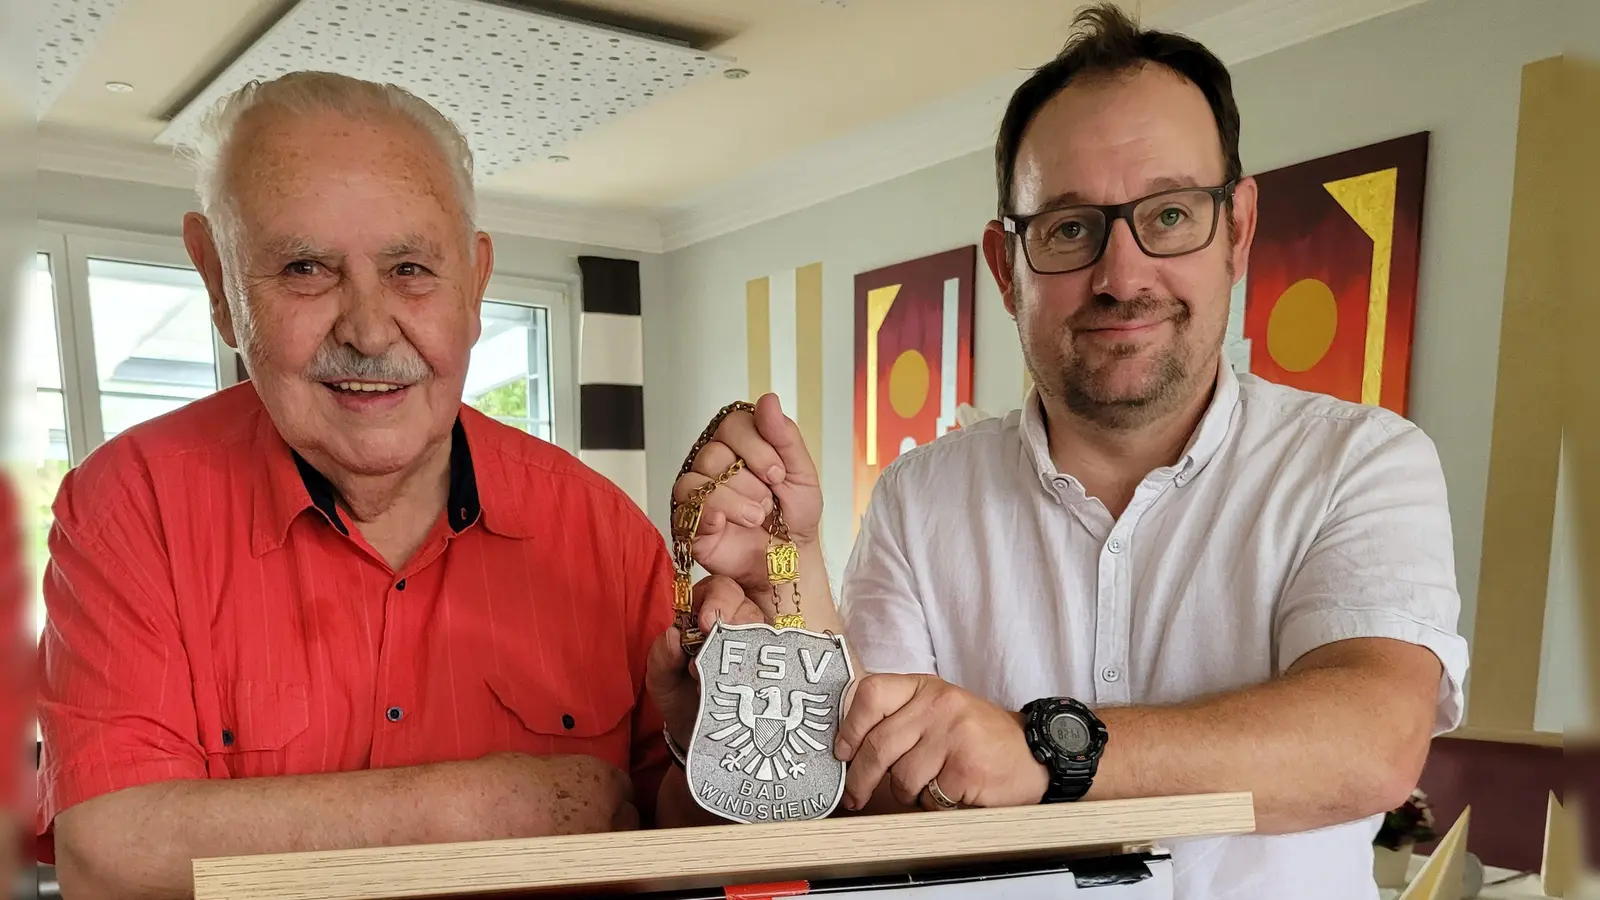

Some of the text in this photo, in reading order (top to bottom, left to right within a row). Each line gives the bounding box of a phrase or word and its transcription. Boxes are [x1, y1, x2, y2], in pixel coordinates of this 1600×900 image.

[719, 639, 834, 684] FSV
[699, 779, 829, 820] WINDSHEIM
[739, 779, 788, 801] BAD
